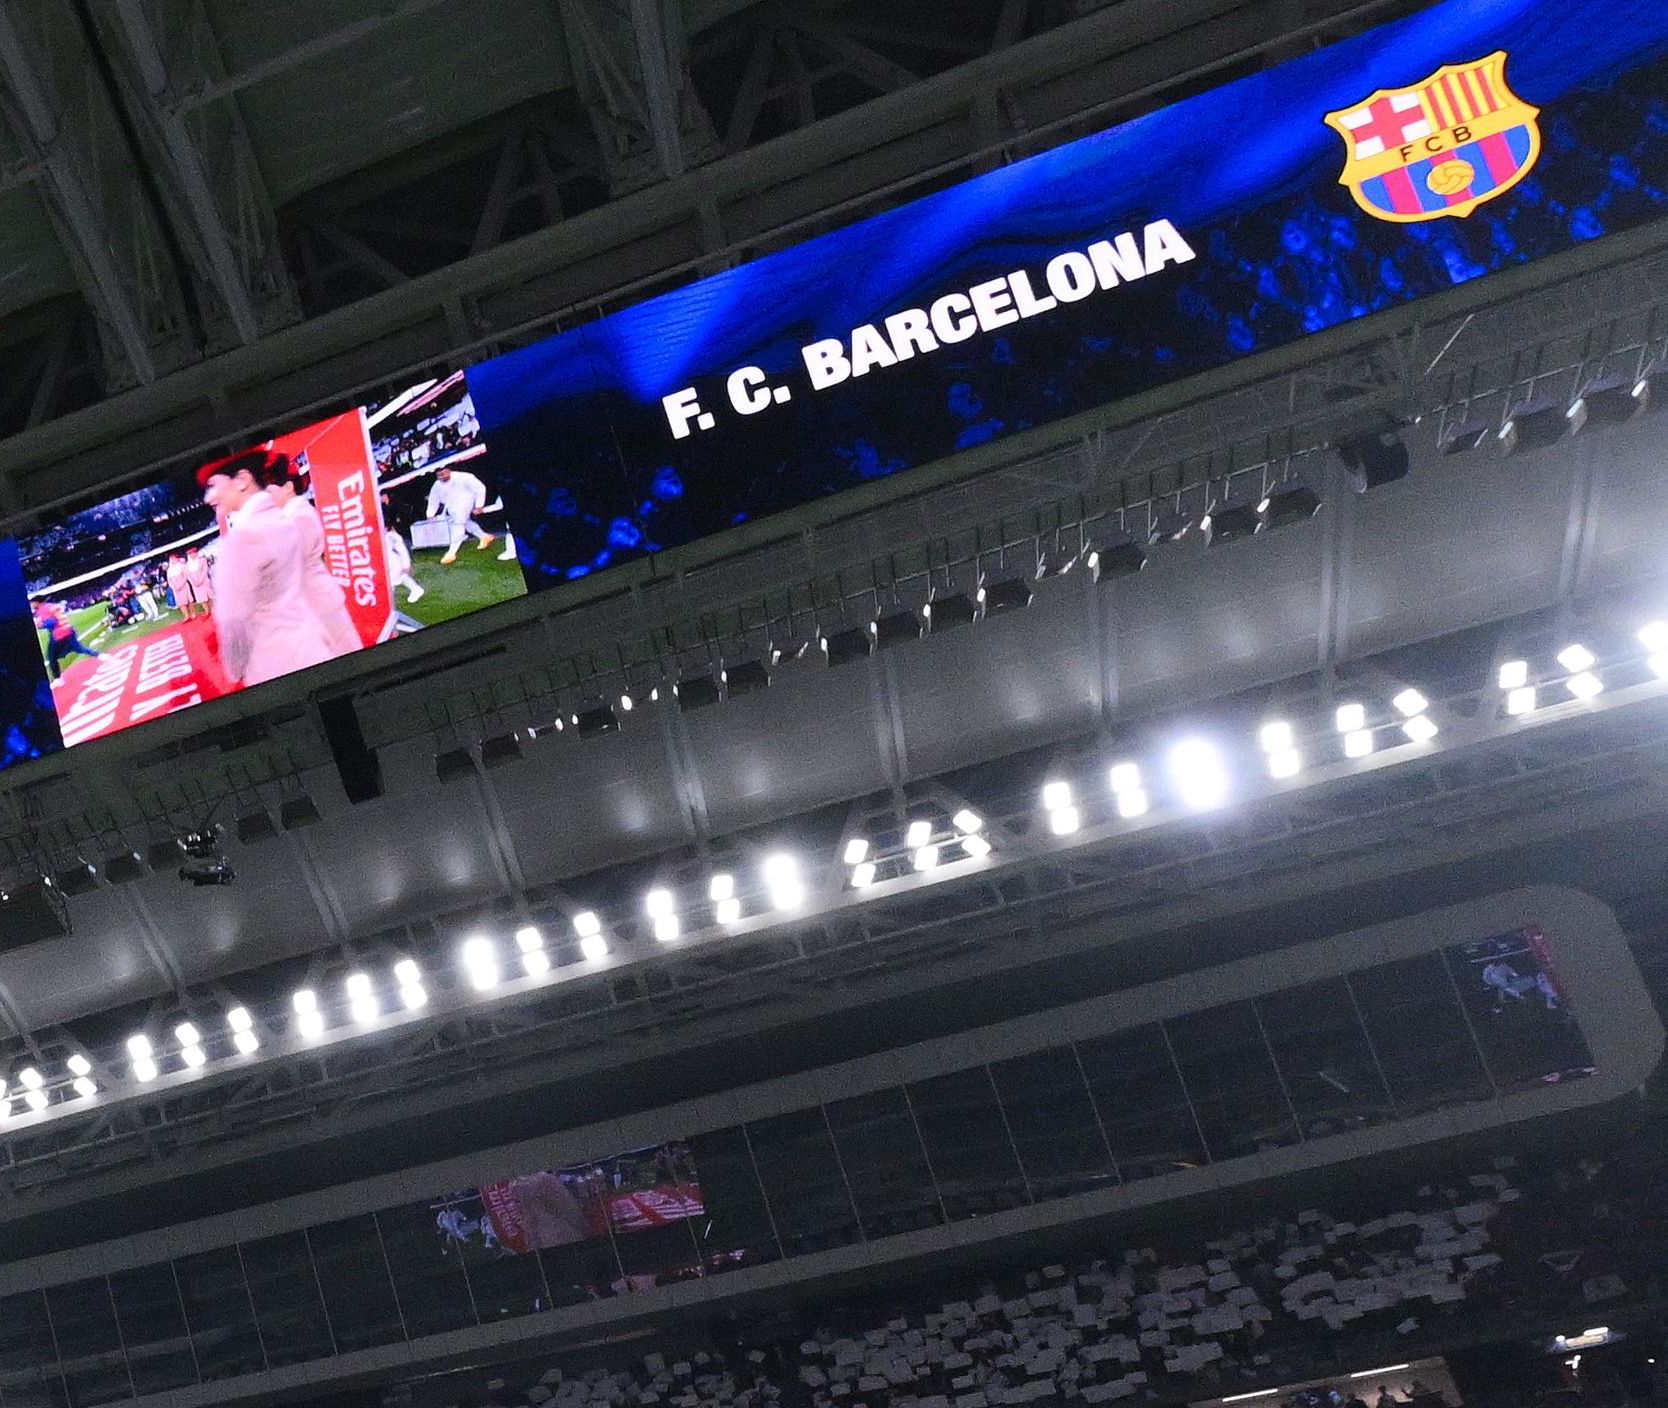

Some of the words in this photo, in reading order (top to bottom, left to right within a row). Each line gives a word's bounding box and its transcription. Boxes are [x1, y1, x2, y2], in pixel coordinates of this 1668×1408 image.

[1399, 126, 1472, 162] FCB
[662, 387, 715, 439] F.
[727, 366, 791, 415] C.
[801, 219, 1196, 391] BARCELONA
[321, 504, 342, 530] FLY
[337, 469, 377, 607] Emirates
